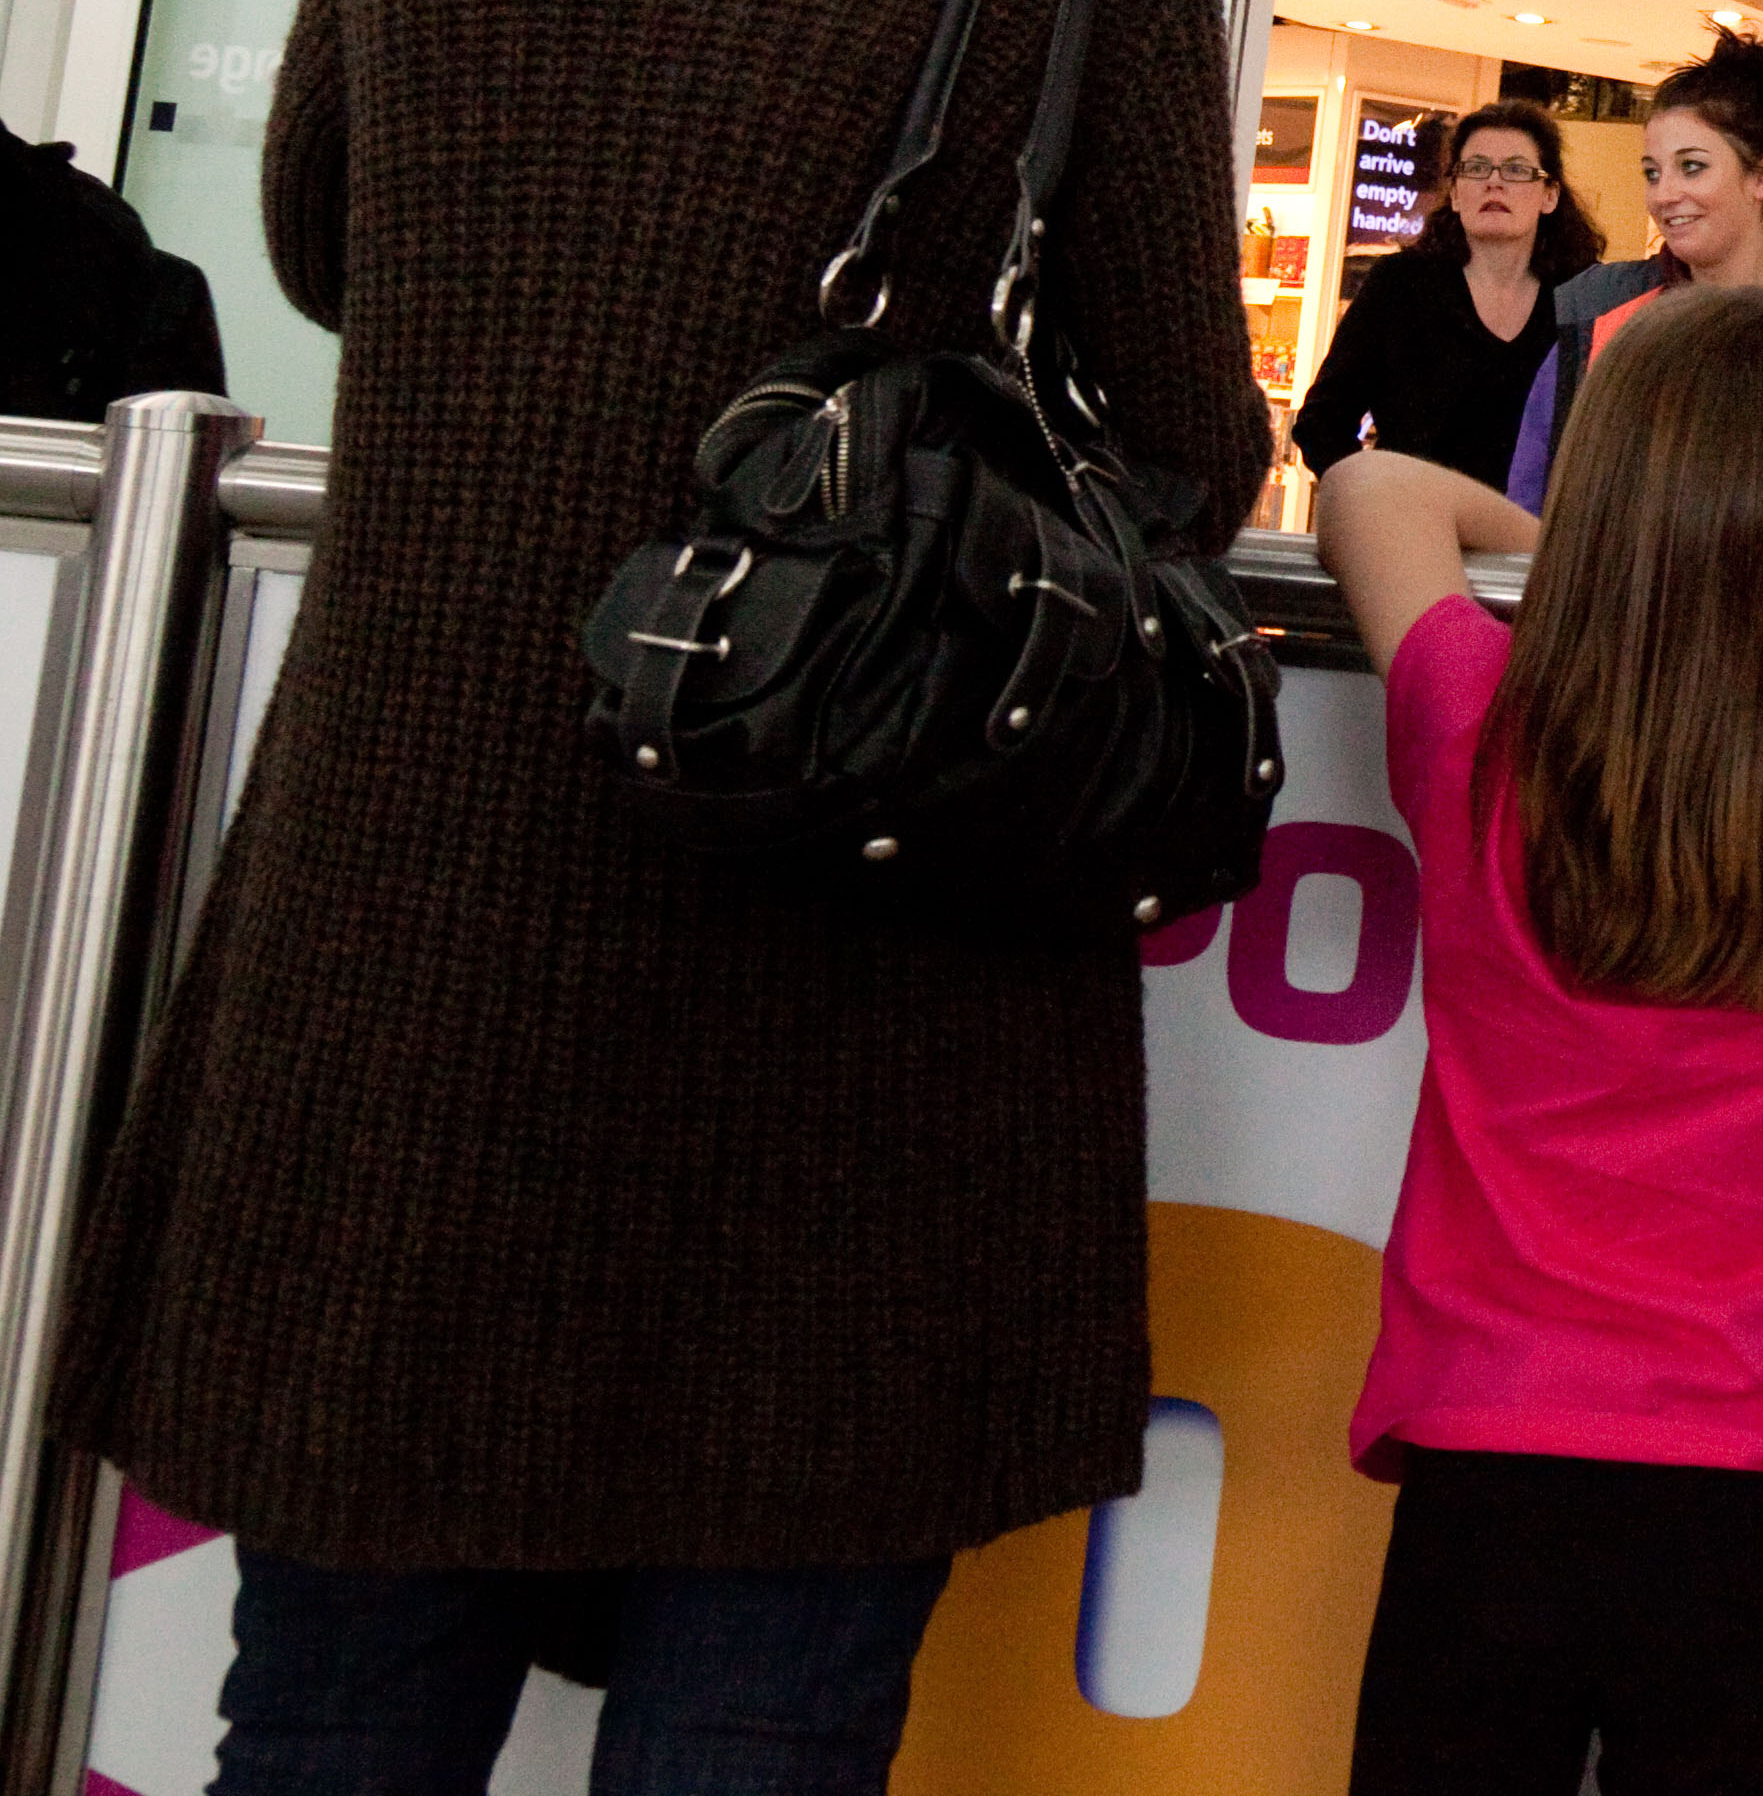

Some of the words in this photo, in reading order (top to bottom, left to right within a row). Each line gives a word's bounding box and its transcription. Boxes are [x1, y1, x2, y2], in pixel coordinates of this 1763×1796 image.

[1362, 118, 1418, 148] Don't
[1358, 151, 1416, 177] arrive
[1355, 182, 1419, 211] empty
